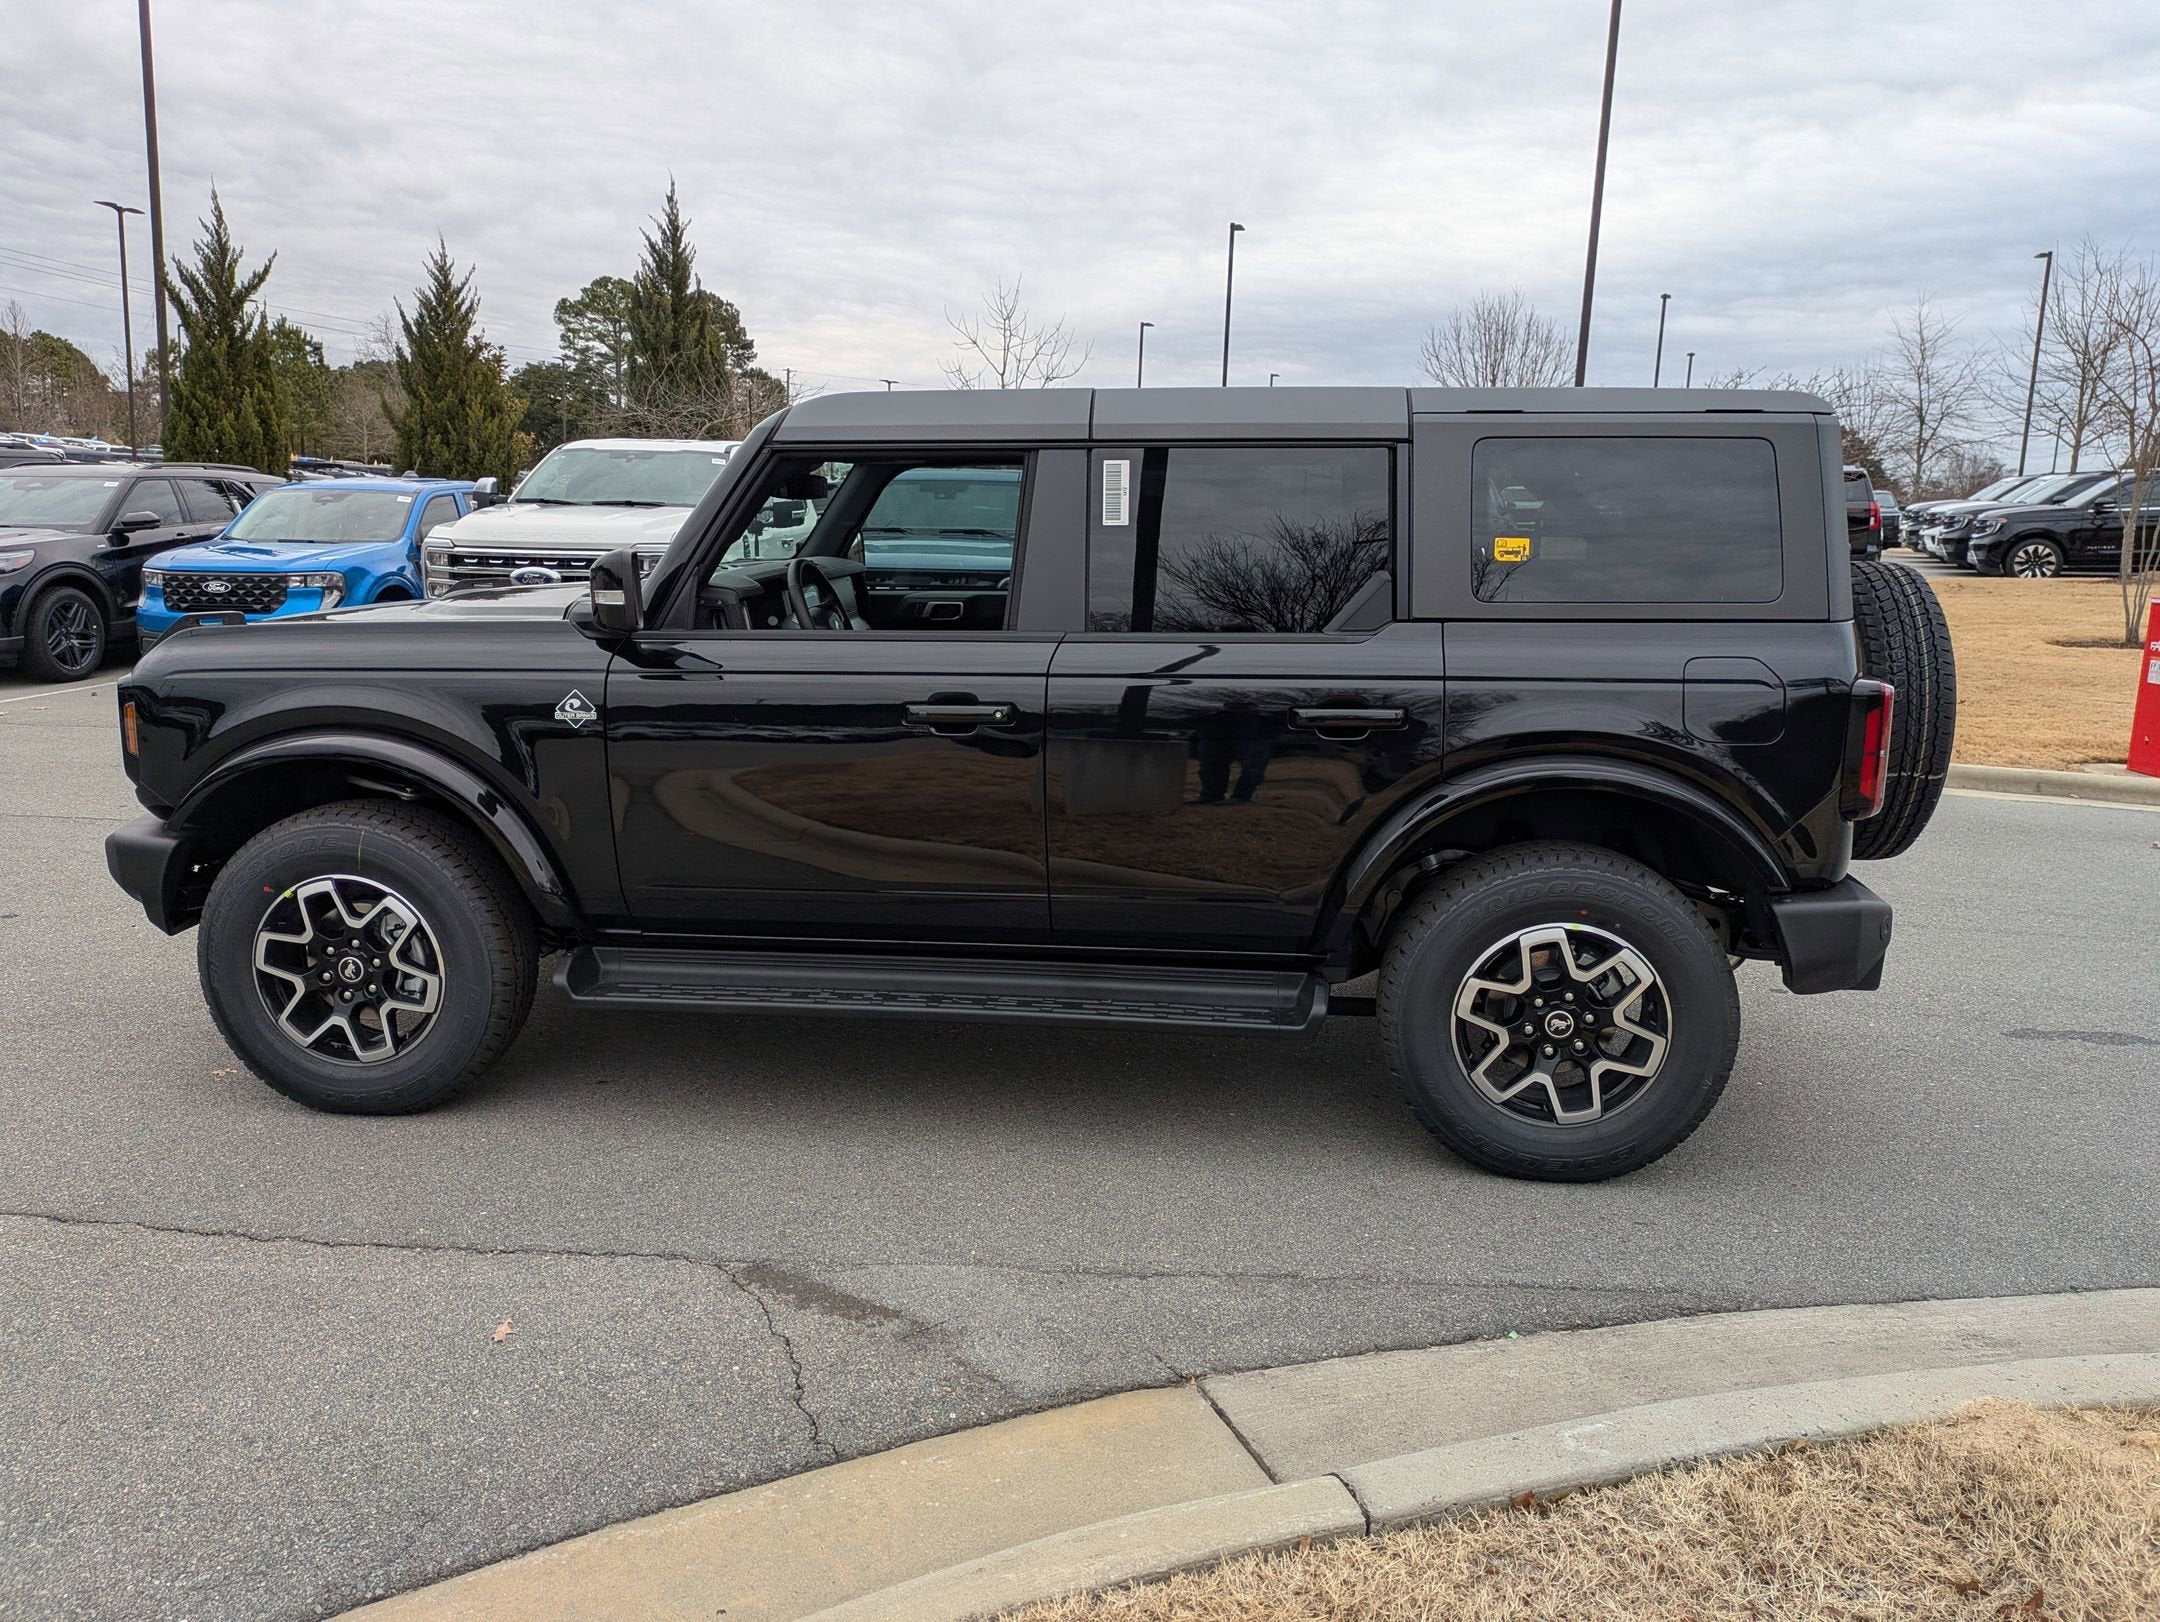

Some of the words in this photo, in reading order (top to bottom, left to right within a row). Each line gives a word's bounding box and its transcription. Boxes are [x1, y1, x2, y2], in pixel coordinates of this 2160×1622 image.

[207, 583, 226, 592] Ford
[521, 573, 546, 585] Ford
[208, 833, 341, 987] BRIDGESTONE
[1456, 880, 1697, 955] BRIDGESTONE
[1455, 1123, 1641, 1173] DUELER
